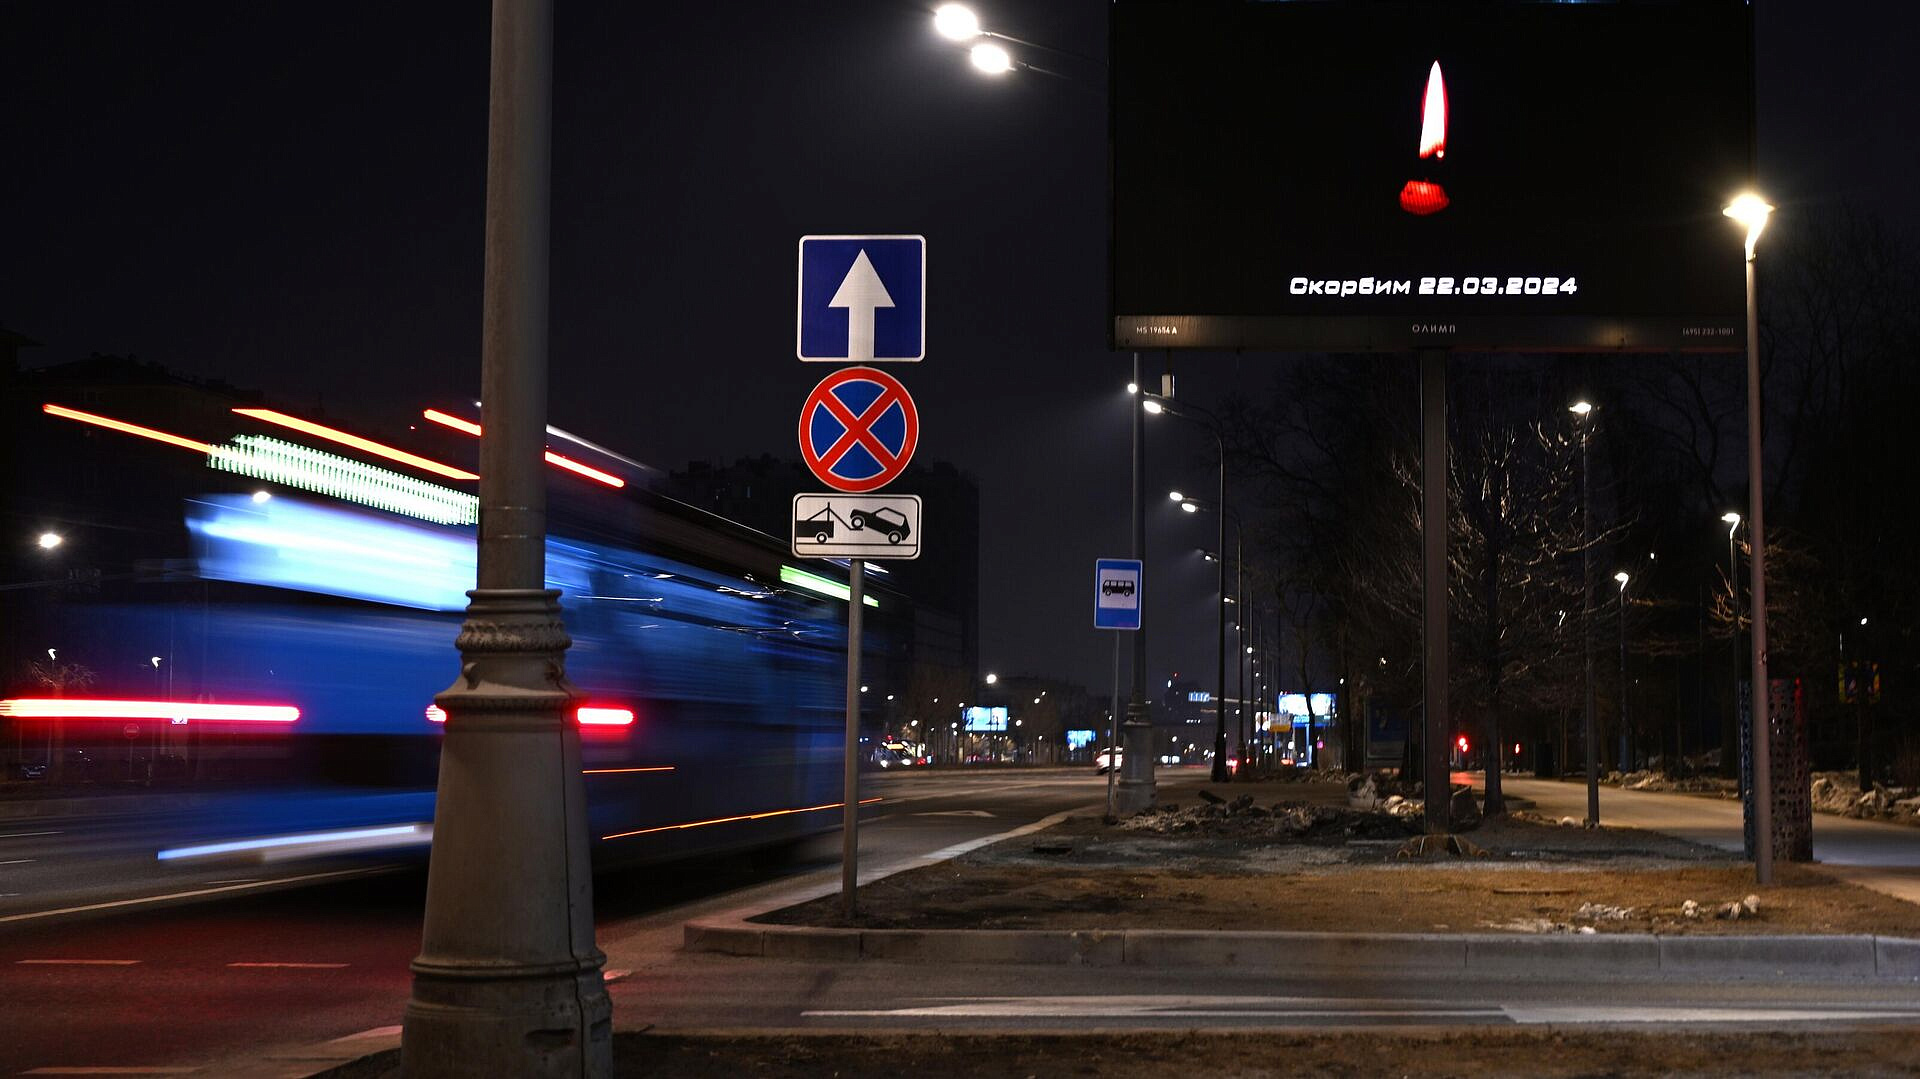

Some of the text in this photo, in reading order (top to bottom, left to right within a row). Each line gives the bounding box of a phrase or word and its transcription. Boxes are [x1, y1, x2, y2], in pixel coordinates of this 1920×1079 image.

[1290, 276, 1578, 297] Скорбим 22.03.2024
[1412, 324, 1456, 334] ОЛИМП
